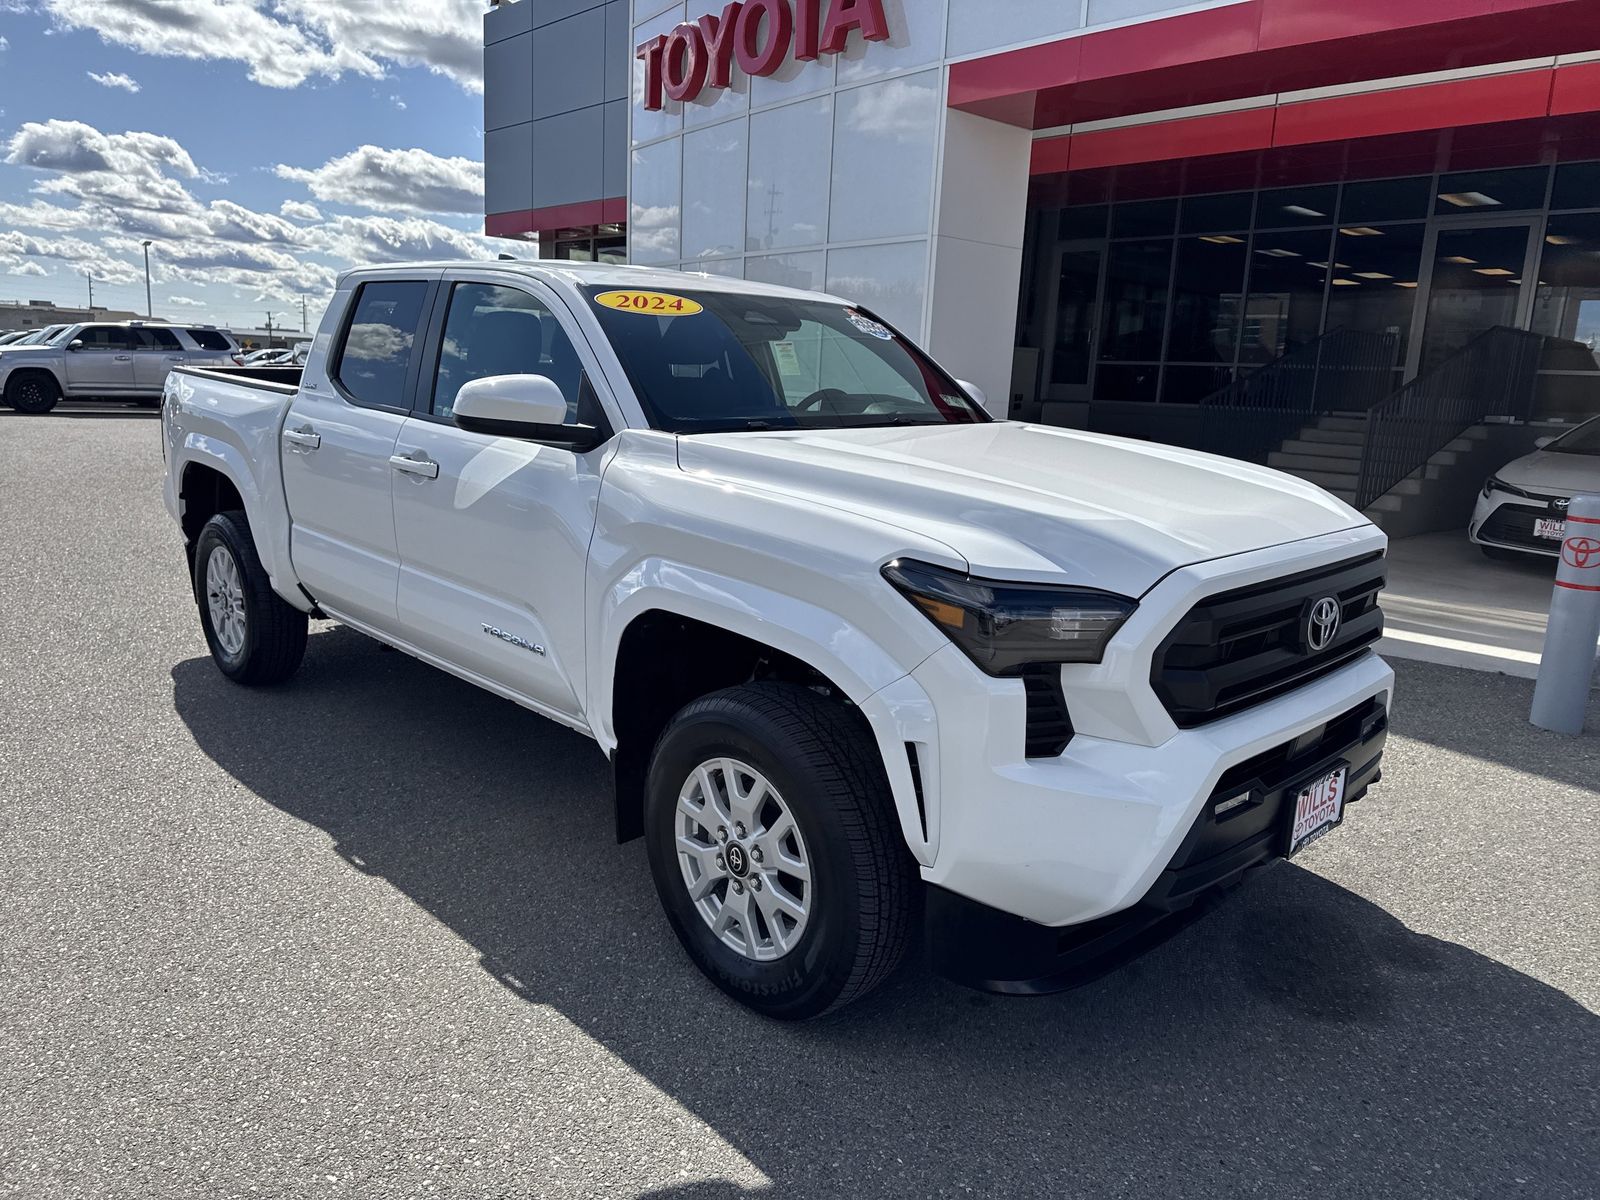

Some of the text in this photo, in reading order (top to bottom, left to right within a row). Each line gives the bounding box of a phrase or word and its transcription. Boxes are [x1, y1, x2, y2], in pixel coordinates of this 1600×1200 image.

[637, 0, 890, 111] TOYOTA
[616, 294, 684, 311] 2024
[1540, 522, 1565, 532] WILL
[480, 622, 546, 657] TACOMA
[1298, 777, 1338, 821] WILLS
[1304, 802, 1336, 832] TOYOTA
